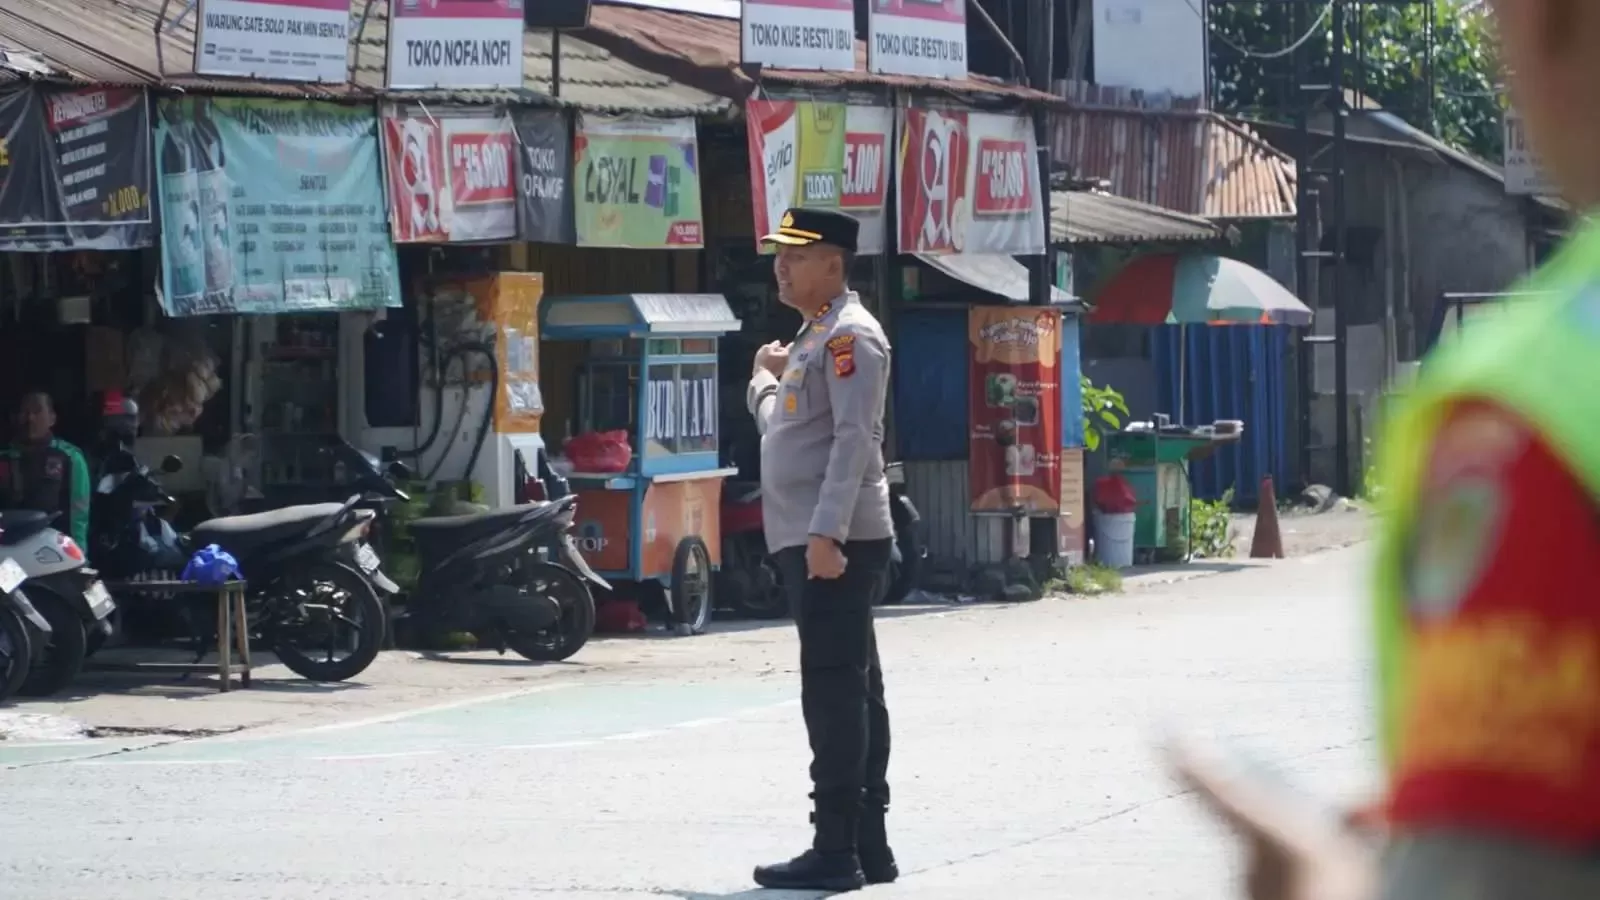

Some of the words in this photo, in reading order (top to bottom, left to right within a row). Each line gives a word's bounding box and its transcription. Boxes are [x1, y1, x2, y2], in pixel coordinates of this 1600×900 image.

[206, 13, 242, 30] WARUNG
[243, 16, 263, 32] SATE
[265, 18, 284, 34] SOLO
[287, 20, 302, 36] PAK
[303, 21, 317, 37] MIN
[319, 22, 346, 39] SENTUL
[750, 24, 779, 46] TOKO
[781, 26, 801, 47] KUE
[803, 27, 834, 49] RESTU
[835, 29, 851, 50] IBU
[406, 40, 442, 66] TOKO
[444, 40, 479, 66] NOFA
[481, 40, 511, 66] NOFI
[876, 32, 900, 54] TOKO
[902, 35, 920, 56] KUE
[921, 37, 948, 59] RESTU
[949, 40, 964, 61] IBU
[528, 147, 556, 170] TOKO
[585, 157, 640, 206] LOYAL
